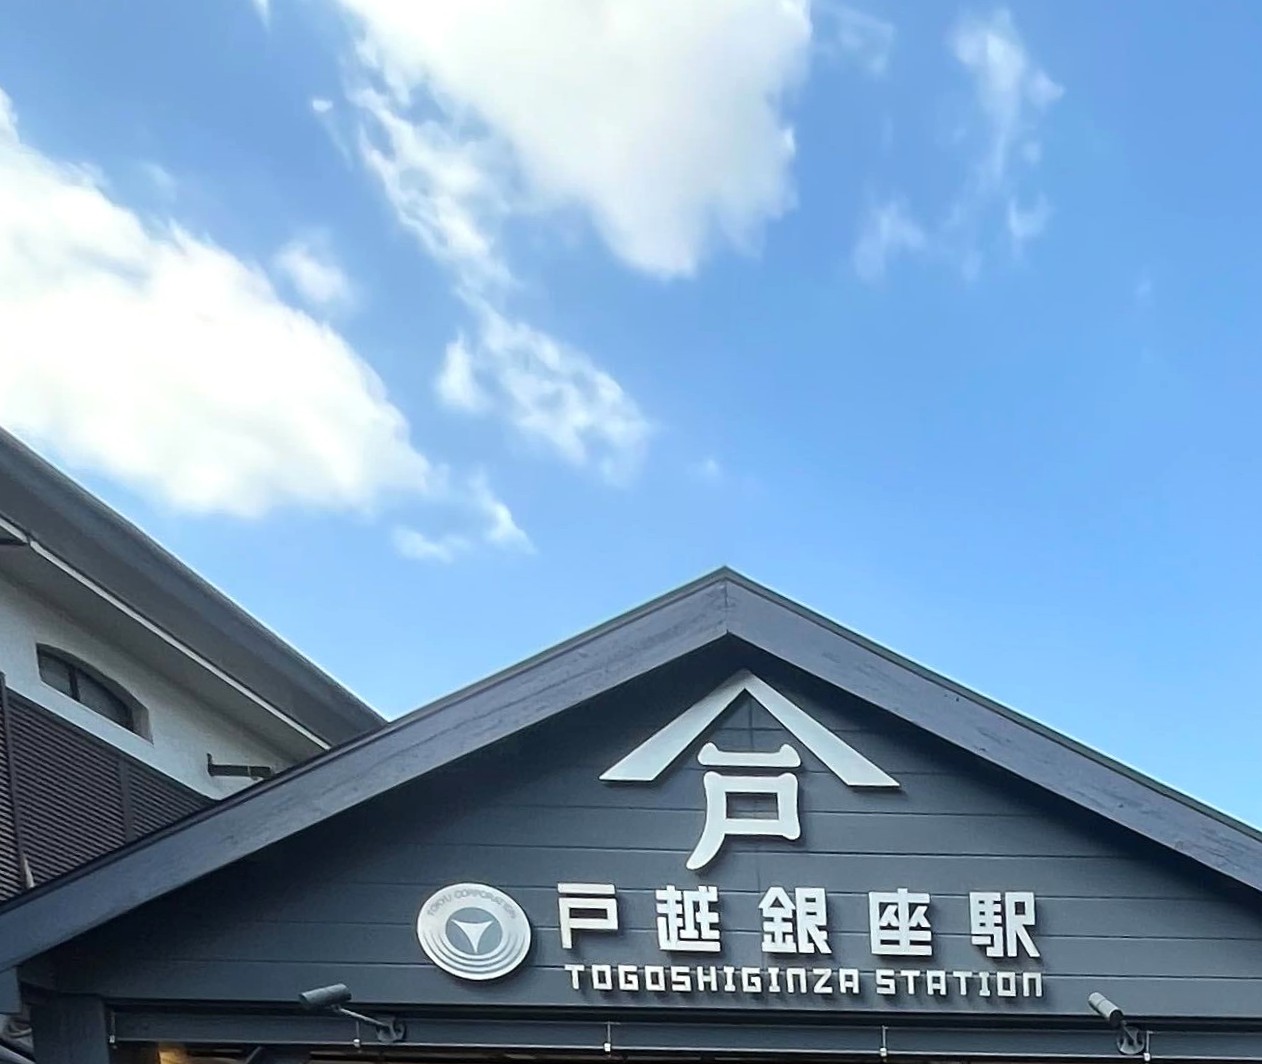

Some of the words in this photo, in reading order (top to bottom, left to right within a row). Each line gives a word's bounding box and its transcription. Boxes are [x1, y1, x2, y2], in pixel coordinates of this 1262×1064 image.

[557, 883, 1041, 958] 戸越銀座駅
[565, 965, 860, 994] TOGOSHIGINZA
[876, 969, 1043, 997] STATION
